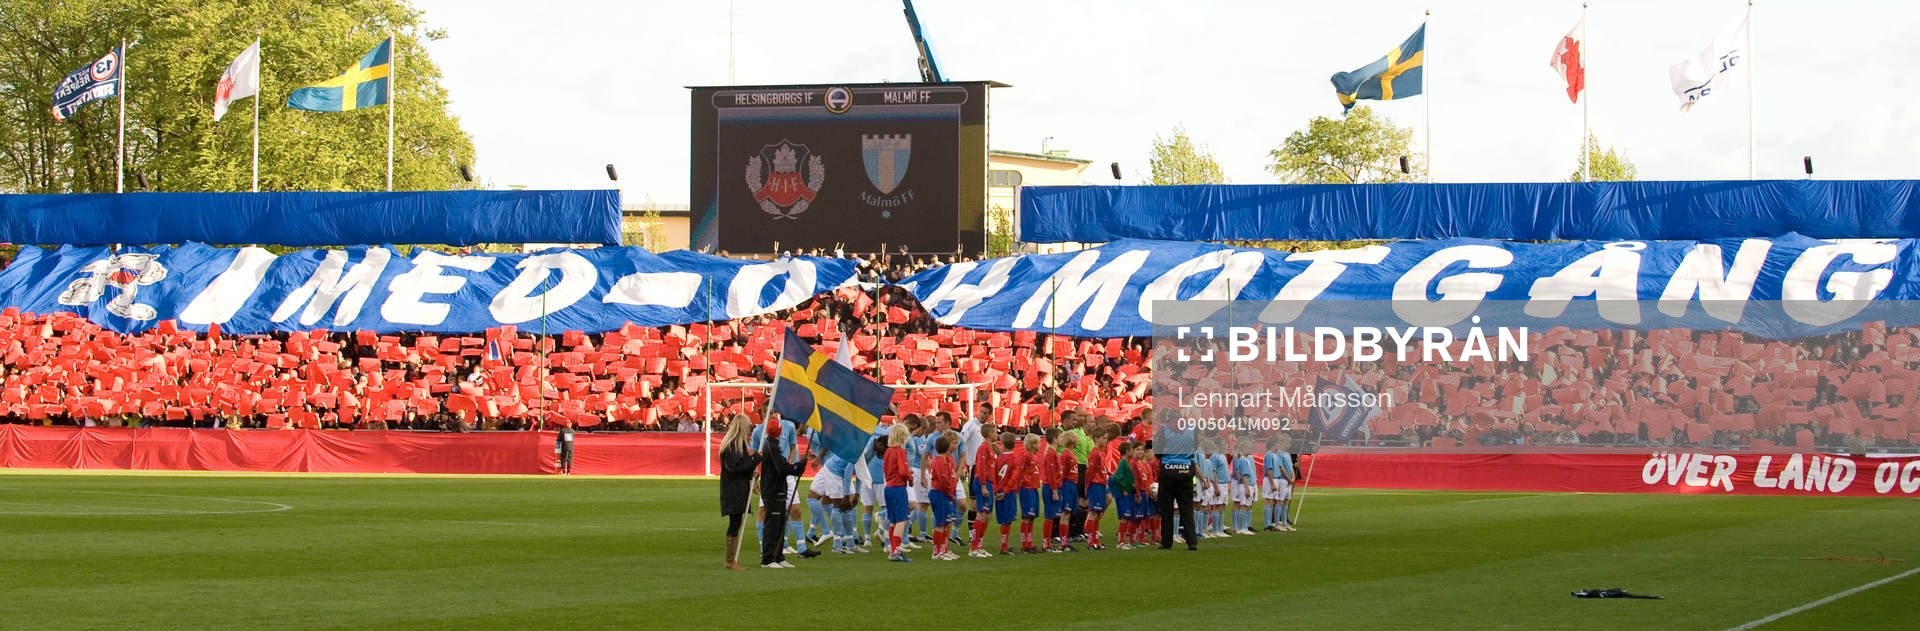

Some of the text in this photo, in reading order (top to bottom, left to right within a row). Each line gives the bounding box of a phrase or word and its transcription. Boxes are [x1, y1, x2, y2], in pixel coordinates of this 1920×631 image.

[735, 92, 814, 105] HELSINGBORGS IF
[884, 90, 931, 103] MALMÖ FF
[859, 190, 916, 208] Malmö FF
[1012, 238, 1897, 330] MOTGÅNG
[998, 464, 1009, 480] 4
[1642, 451, 1737, 492] ÖVER
[1753, 453, 1857, 493] LAND
